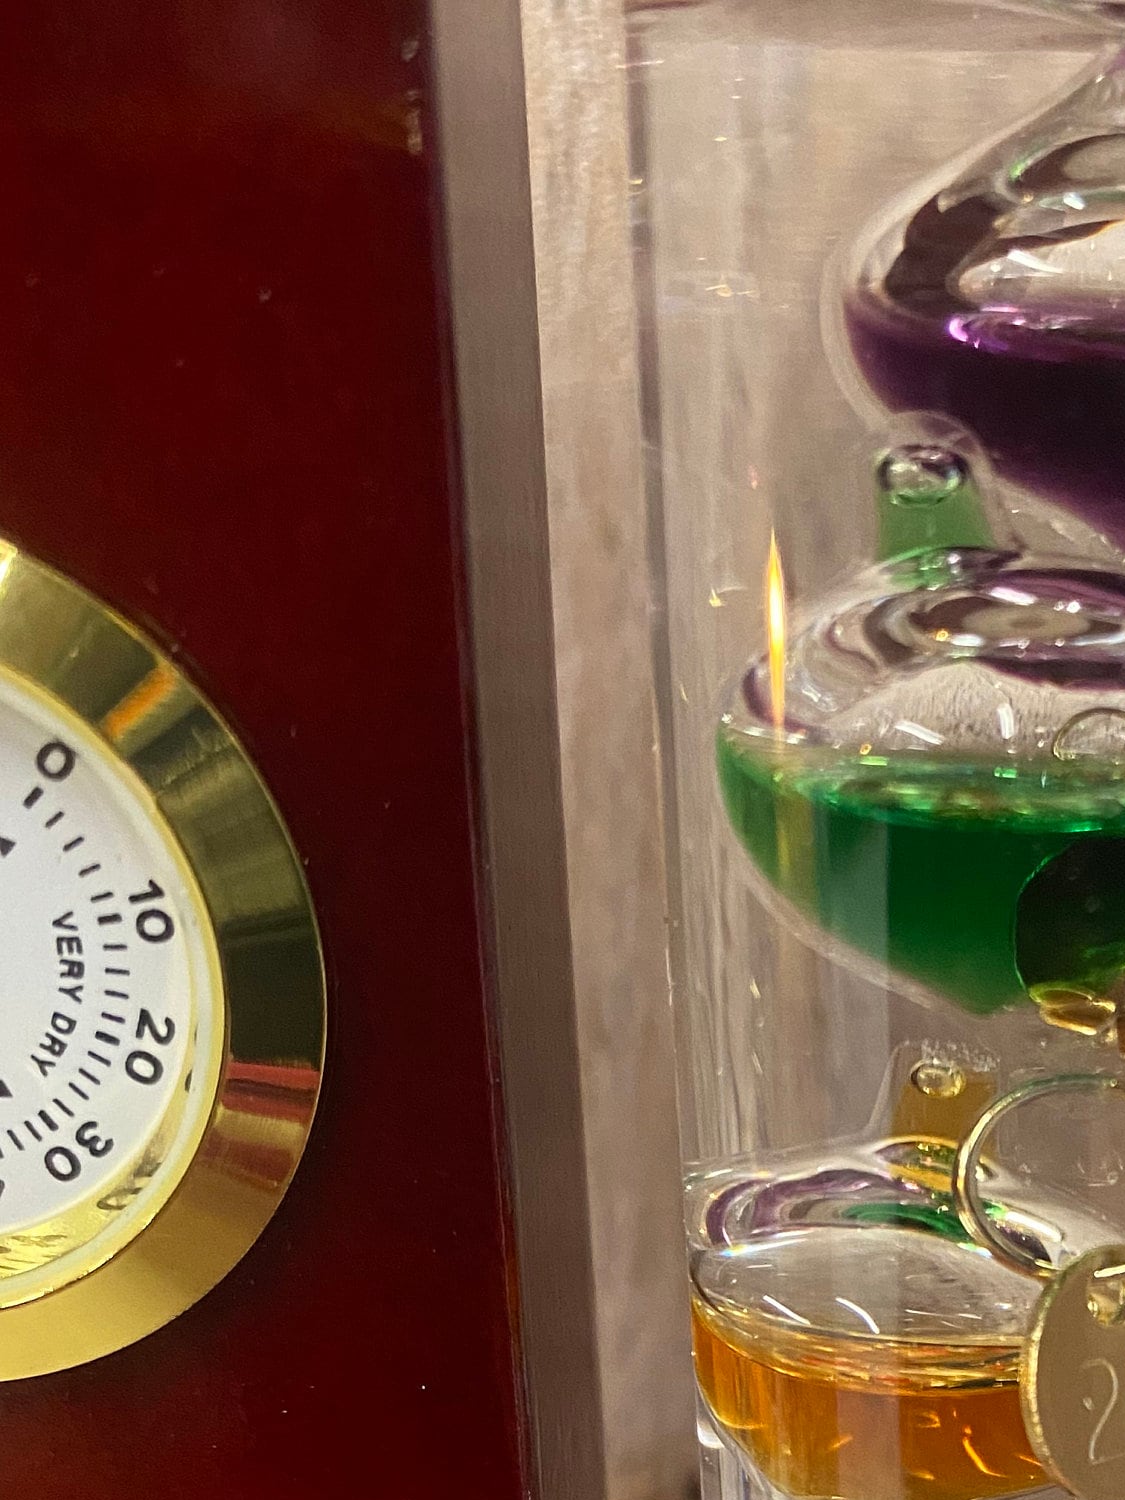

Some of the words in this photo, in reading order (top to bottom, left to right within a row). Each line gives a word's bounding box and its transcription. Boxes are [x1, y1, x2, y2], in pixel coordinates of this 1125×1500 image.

[128, 878, 175, 944] 10
[52, 911, 84, 1004] VERY
[30, 1011, 78, 1077] DRY
[124, 1009, 175, 1086] 20
[44, 1121, 114, 1182] 30
